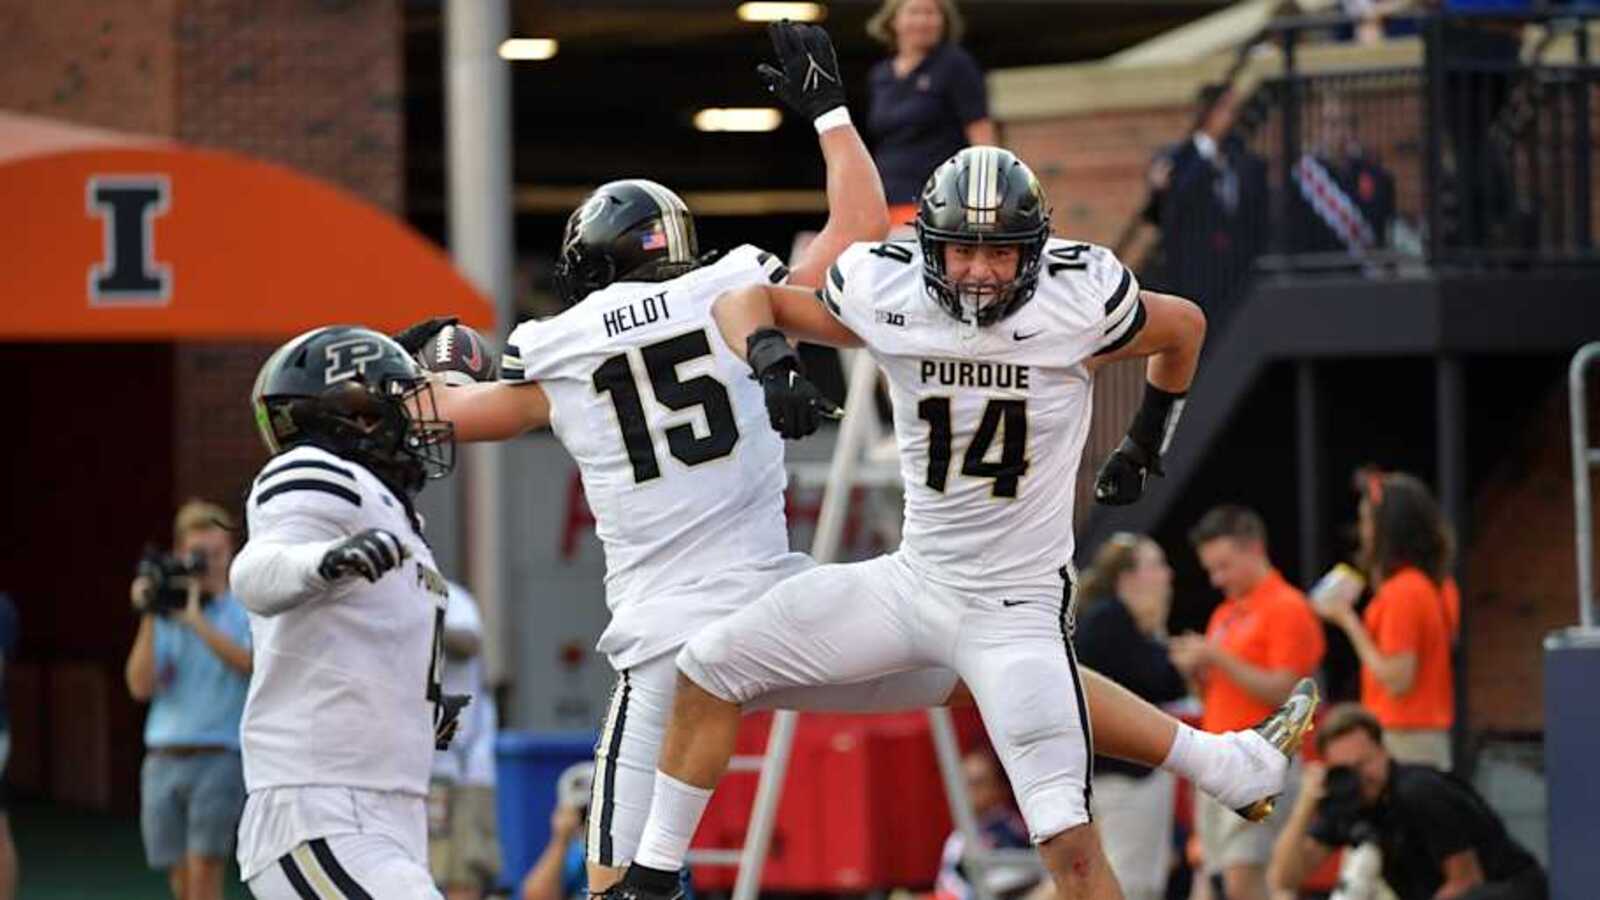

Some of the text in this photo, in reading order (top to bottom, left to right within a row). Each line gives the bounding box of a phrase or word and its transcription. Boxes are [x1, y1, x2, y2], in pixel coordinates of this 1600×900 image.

[87, 174, 172, 306] I
[1048, 245, 1091, 277] 14
[603, 290, 669, 337] HELDT
[325, 338, 384, 385] P
[920, 360, 1030, 390] PURDUE
[592, 329, 740, 486] 15
[917, 396, 1029, 499] 14
